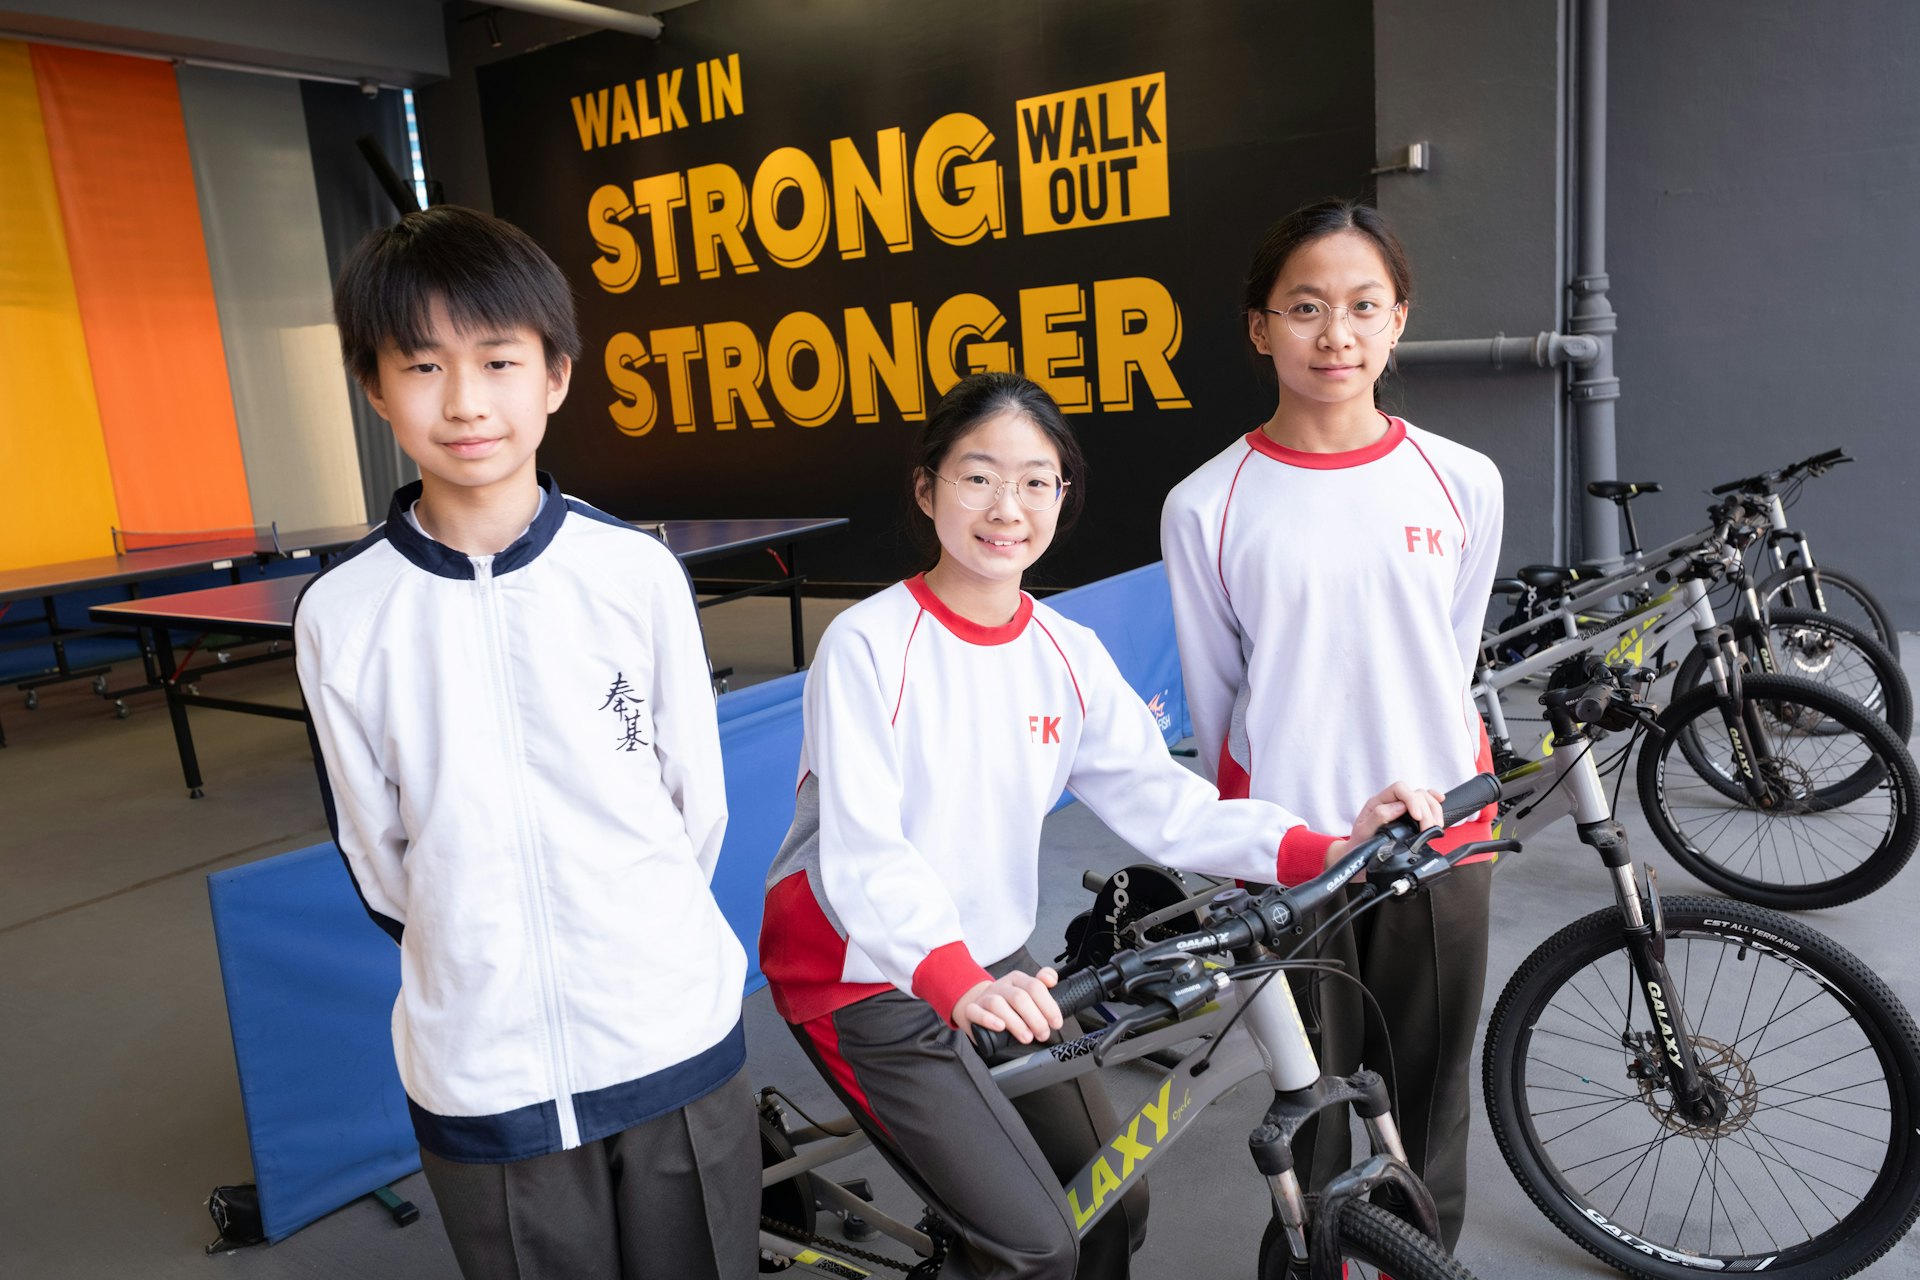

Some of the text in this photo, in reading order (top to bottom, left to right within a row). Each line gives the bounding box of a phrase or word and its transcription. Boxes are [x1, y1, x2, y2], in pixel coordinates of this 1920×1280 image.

[571, 53, 744, 151] WALK IN
[1022, 82, 1162, 165] WALK
[588, 112, 1006, 294] STRONG
[1048, 157, 1138, 226] OUT
[604, 277, 1192, 437] STRONGER
[1405, 526, 1444, 557] FK
[1028, 715, 1062, 744] FK
[1730, 727, 1753, 779] GALAXY
[1326, 855, 1366, 891] GALAXY
[1703, 919, 1801, 952] CST ALL TERRAINS
[1647, 981, 1684, 1070] GALAXY
